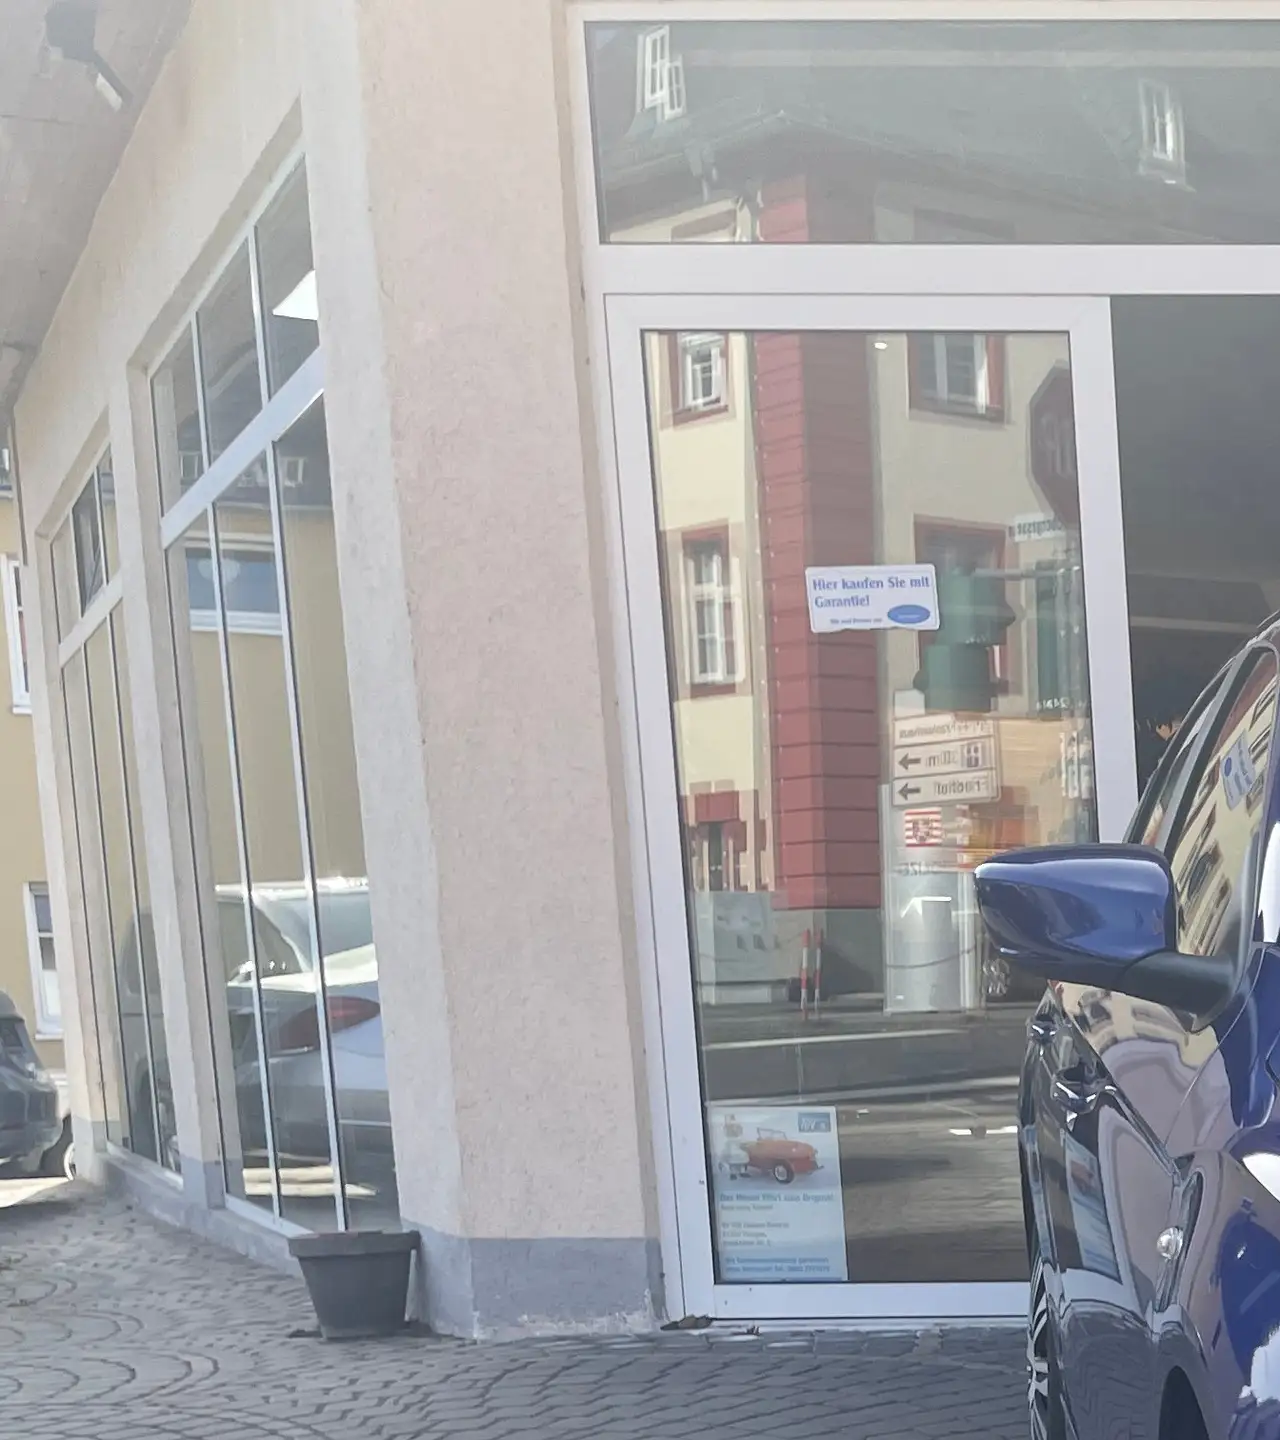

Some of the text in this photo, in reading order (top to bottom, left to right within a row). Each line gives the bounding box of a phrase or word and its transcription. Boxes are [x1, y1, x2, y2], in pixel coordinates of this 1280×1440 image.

[812, 576, 930, 591] Hier kaufen Sie mit
